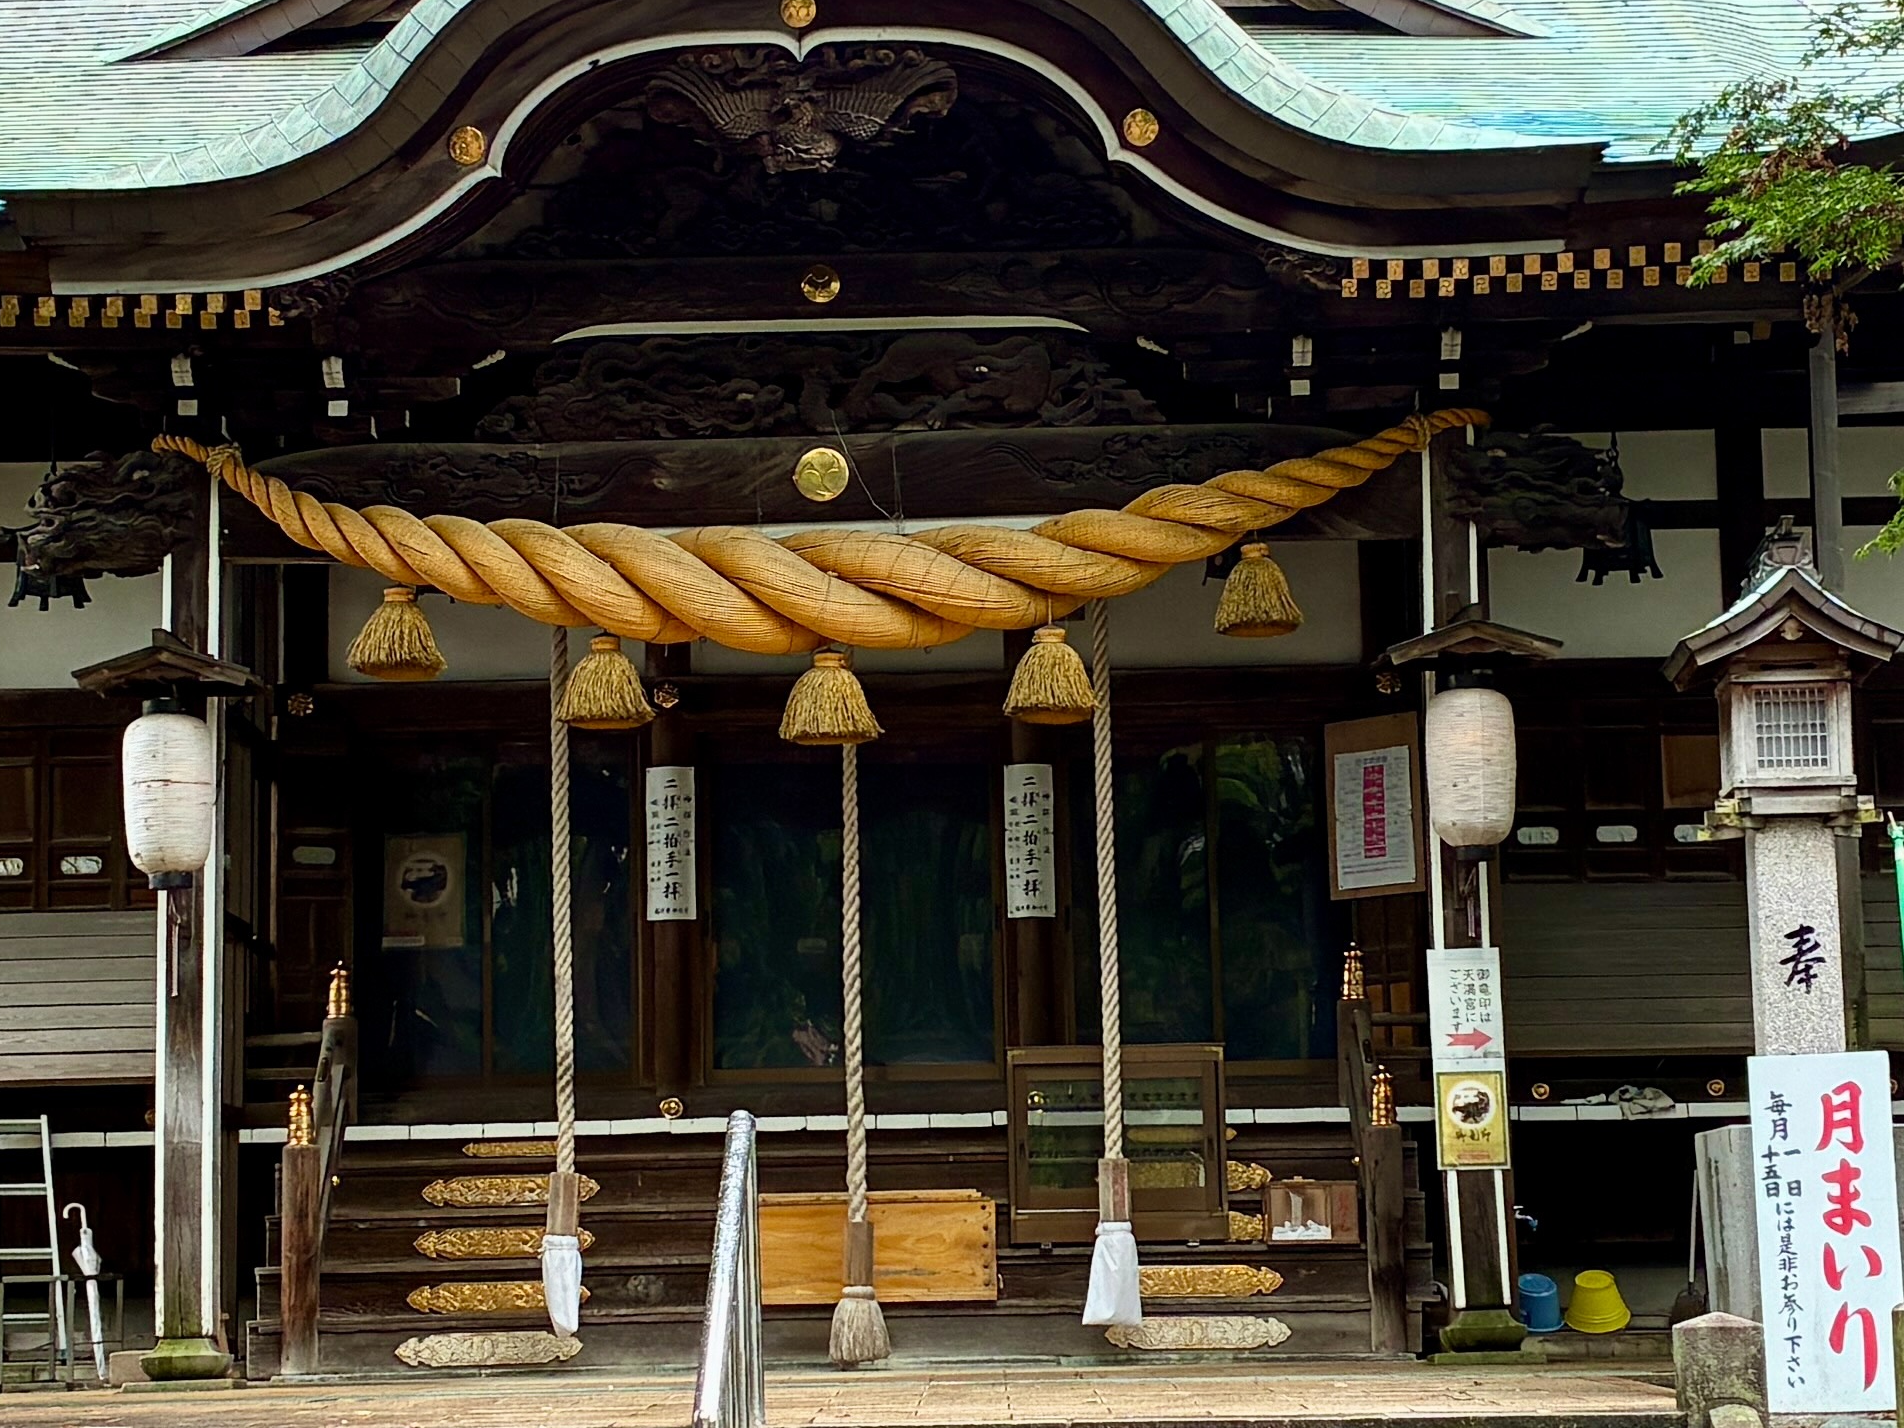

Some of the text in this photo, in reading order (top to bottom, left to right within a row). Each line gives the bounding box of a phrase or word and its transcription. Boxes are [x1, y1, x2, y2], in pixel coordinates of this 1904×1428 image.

[1778, 923, 1827, 994] 奉
[1449, 968, 1463, 1033] ございます
[1815, 1080, 1883, 1392] 月まいり
